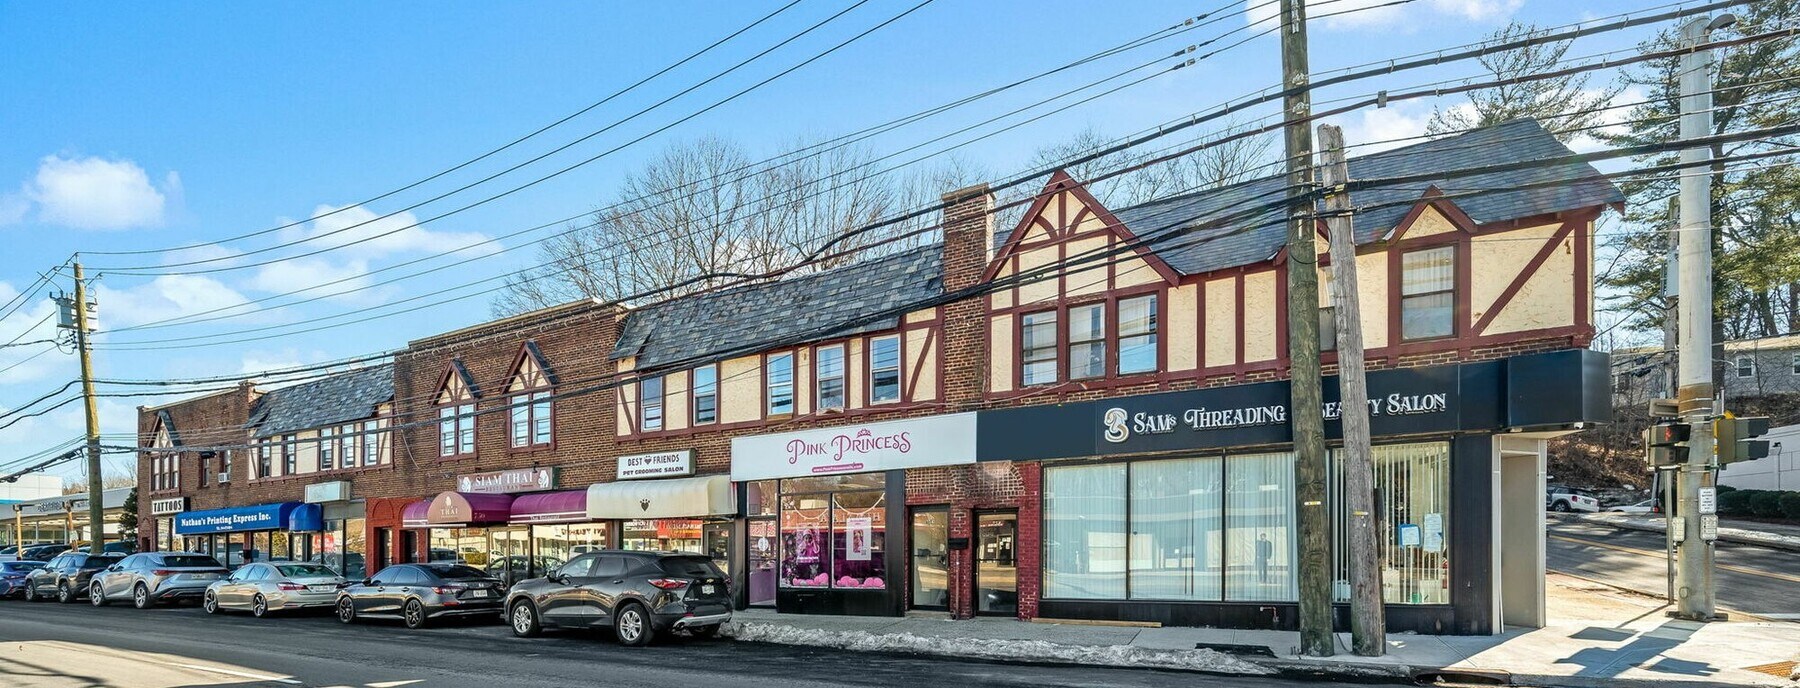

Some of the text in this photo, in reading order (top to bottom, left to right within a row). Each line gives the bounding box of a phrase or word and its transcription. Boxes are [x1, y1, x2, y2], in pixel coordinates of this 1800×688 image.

[1184, 405, 1286, 429] THREADING
[1387, 393, 1446, 414] SALON
[786, 431, 911, 464] PINK PRINCESS
[628, 454, 680, 467] BEST FRIENDS
[475, 471, 534, 487] SIAM THAI
[153, 500, 182, 512] TATTOOS
[181, 512, 271, 527] Nathan's Printing Express Inc.
